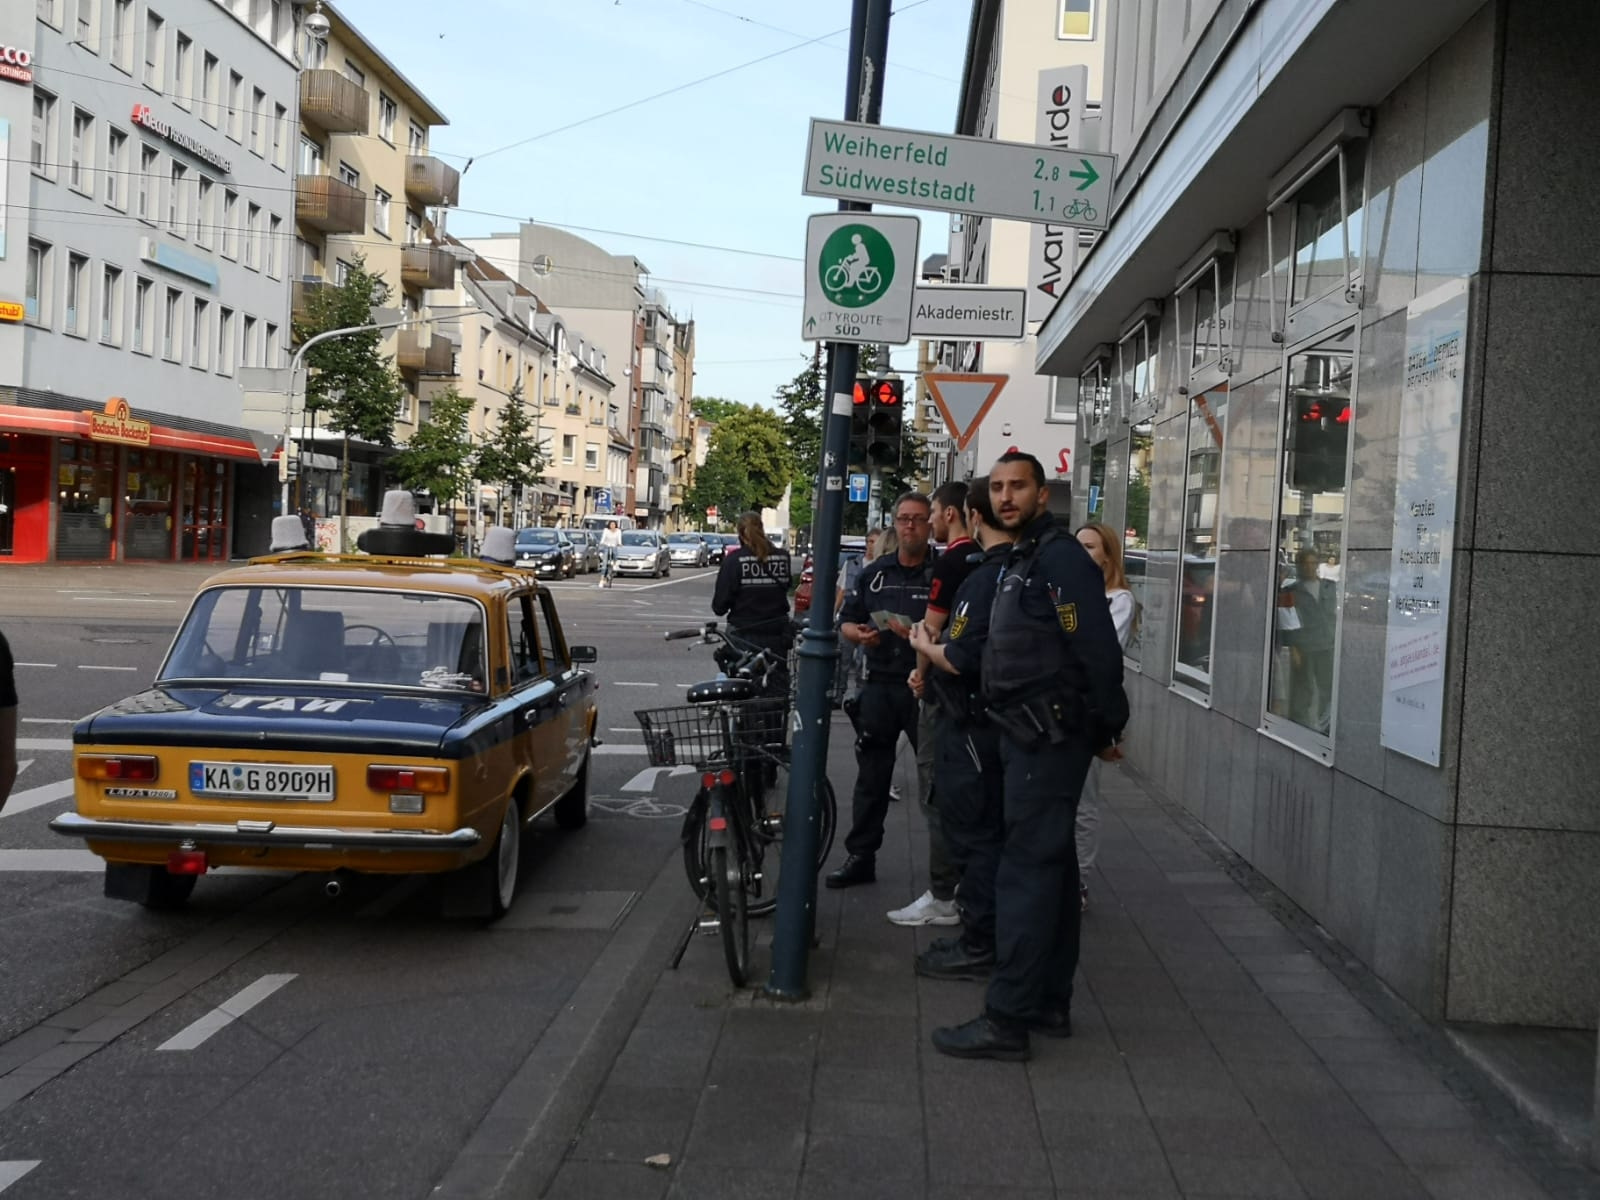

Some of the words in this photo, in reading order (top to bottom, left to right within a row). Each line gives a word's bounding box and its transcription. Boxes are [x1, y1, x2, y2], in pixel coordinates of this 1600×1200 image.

[823, 131, 949, 167] Weiherfeld
[819, 164, 976, 203] Südweststadt
[915, 304, 1015, 322] Akademiestr.
[834, 318, 861, 336] SÜD
[93, 417, 119, 435] Badische
[205, 767, 230, 790] KA
[247, 770, 260, 791] G
[265, 771, 331, 793] 8909H
